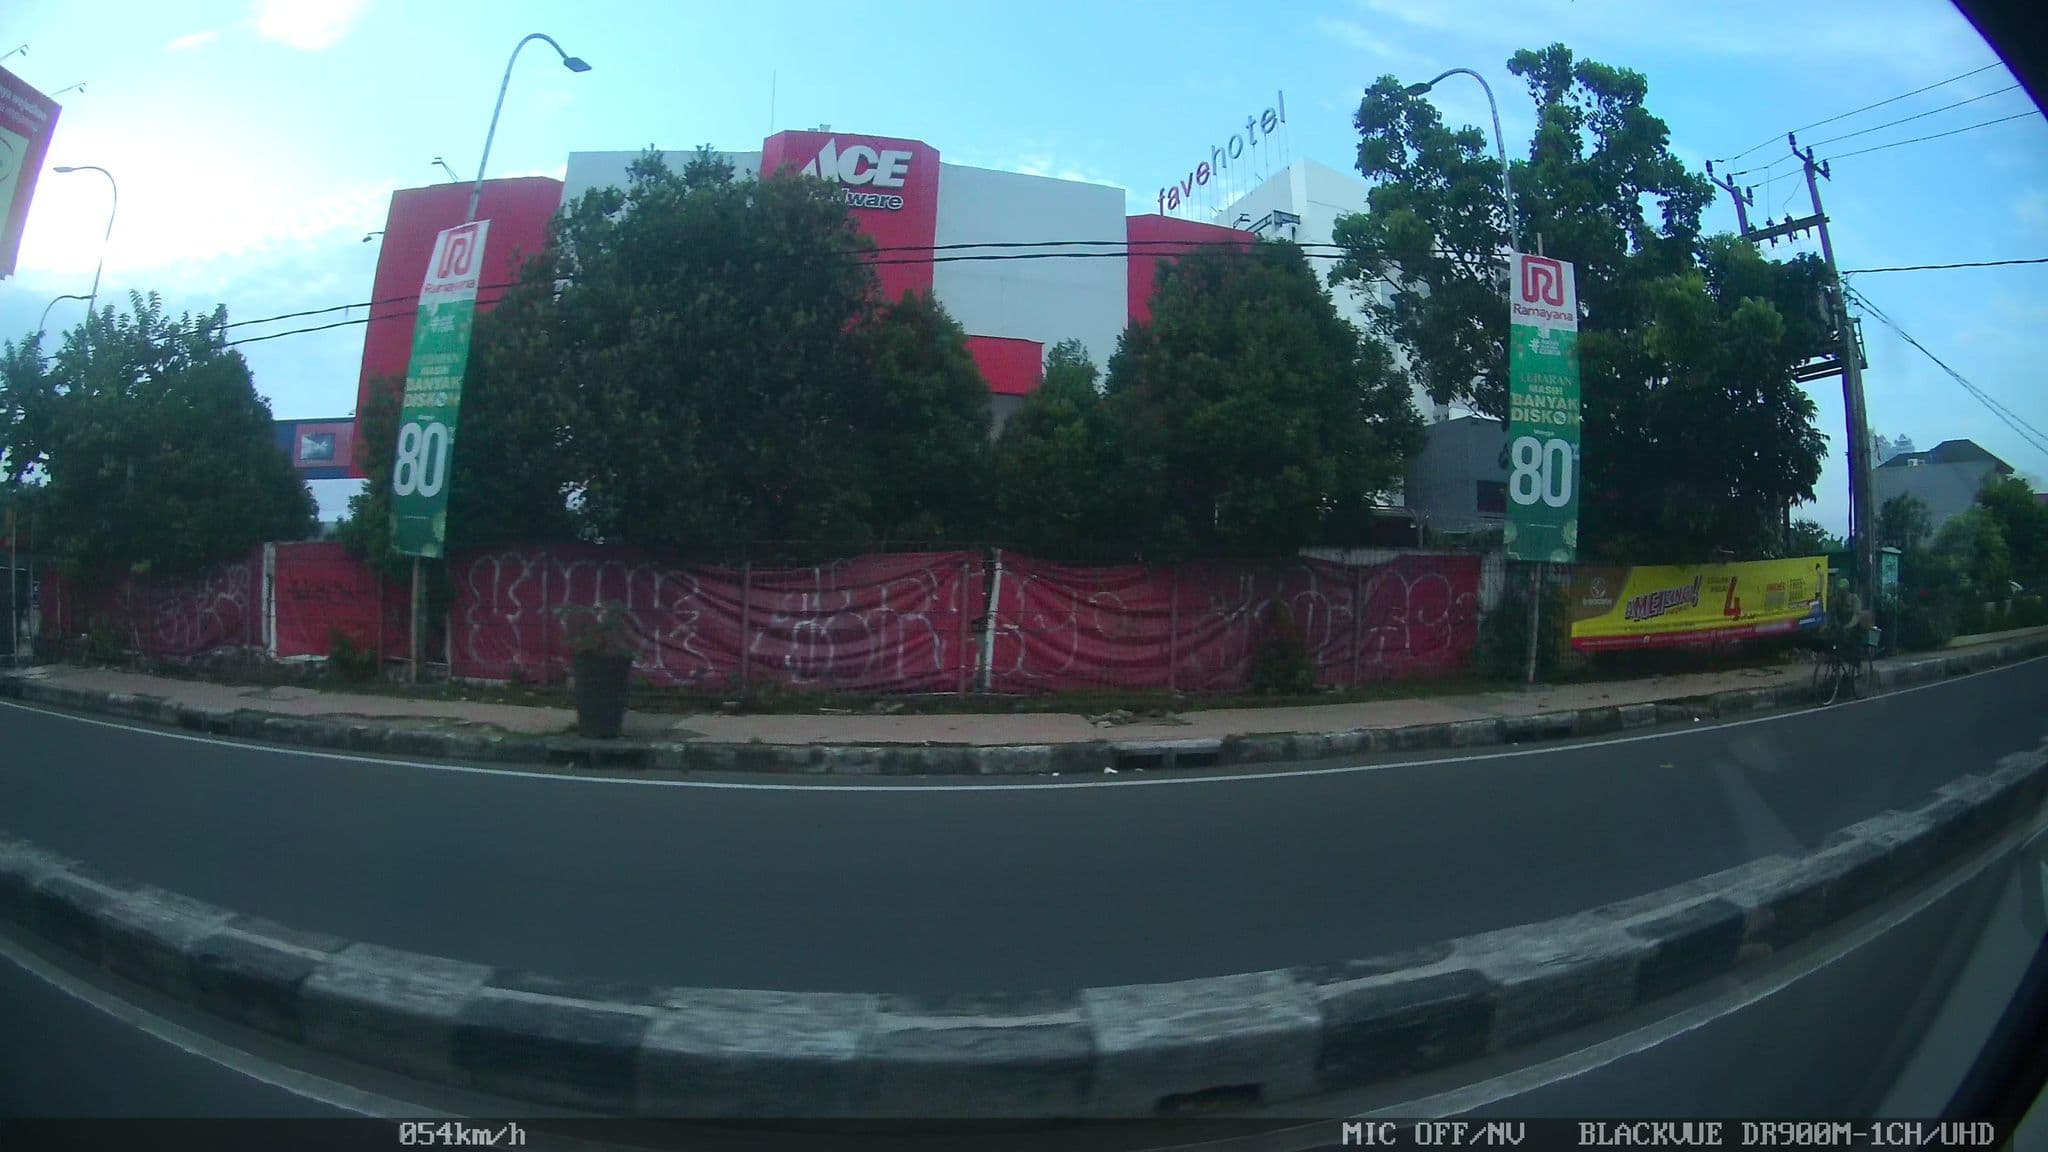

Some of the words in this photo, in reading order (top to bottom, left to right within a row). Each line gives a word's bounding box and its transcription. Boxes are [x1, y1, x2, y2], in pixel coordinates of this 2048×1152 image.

[800, 137, 912, 187] ACE
[1158, 90, 1286, 216] favehotel
[1513, 303, 1574, 322] Ramayana
[1510, 392, 1578, 410] BANYAK
[1510, 408, 1579, 425] DISKON
[393, 422, 448, 497] 80
[1510, 436, 1572, 508] 80
